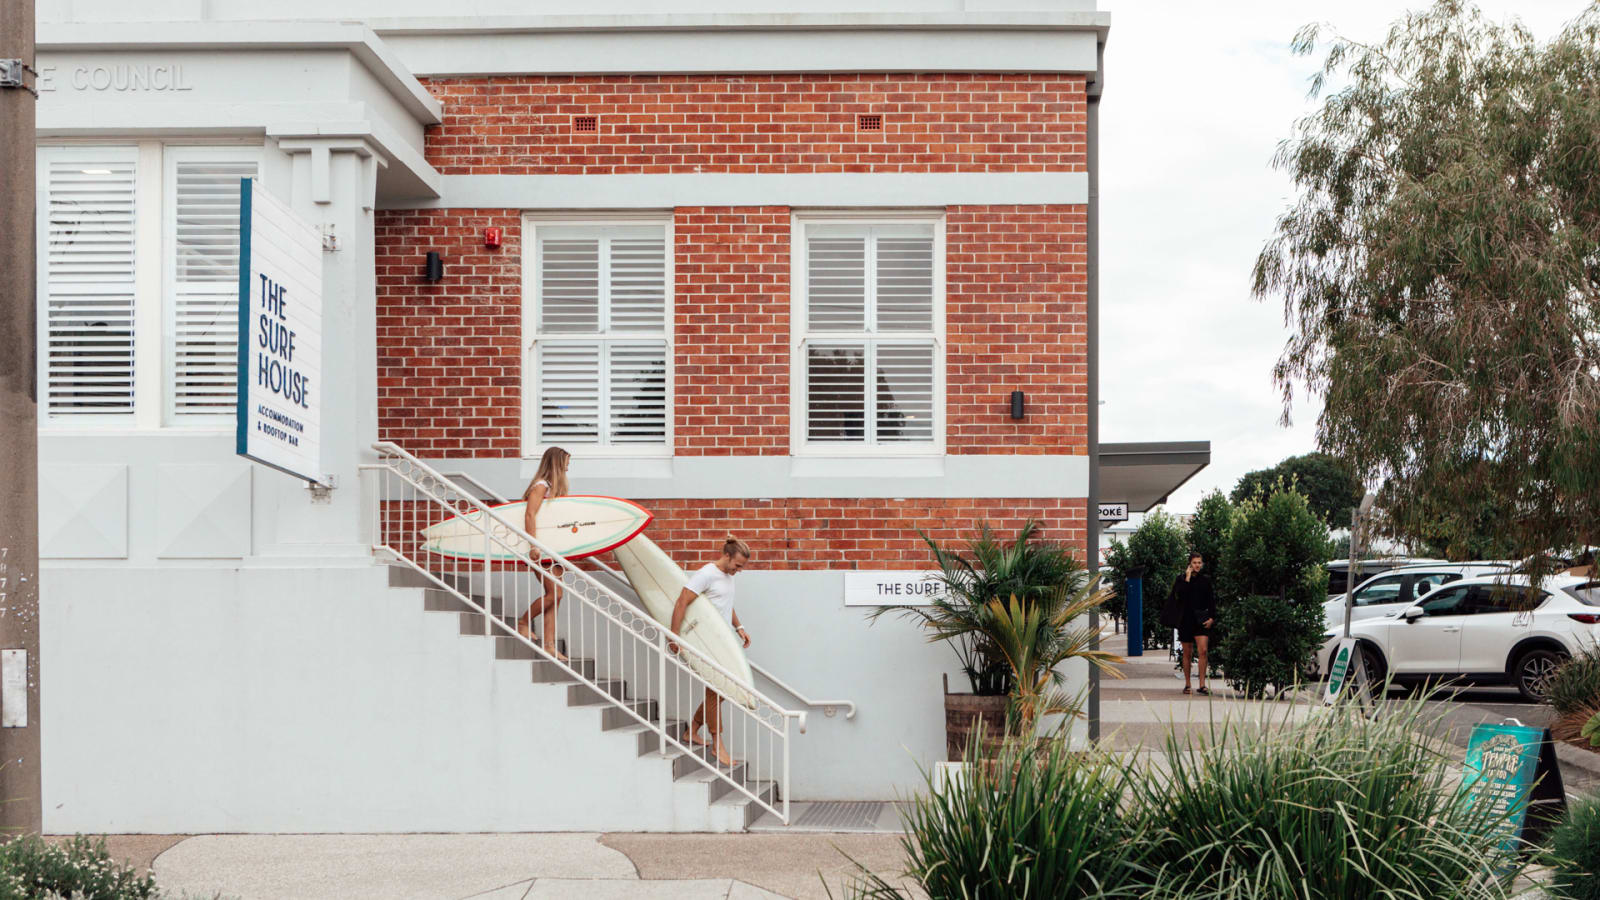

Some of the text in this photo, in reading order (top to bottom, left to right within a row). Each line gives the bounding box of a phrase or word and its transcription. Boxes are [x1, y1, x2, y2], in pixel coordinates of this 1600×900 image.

[71, 65, 193, 93] COUNCIL
[259, 273, 287, 320] THE
[258, 314, 296, 362] SURF
[258, 352, 309, 409] HOUSE
[257, 403, 304, 433] ACCOMMODATION
[263, 423, 287, 442] ROOFTOP
[288, 434, 299, 447] BAR
[876, 582, 902, 596] THE
[905, 582, 941, 596] SURF
